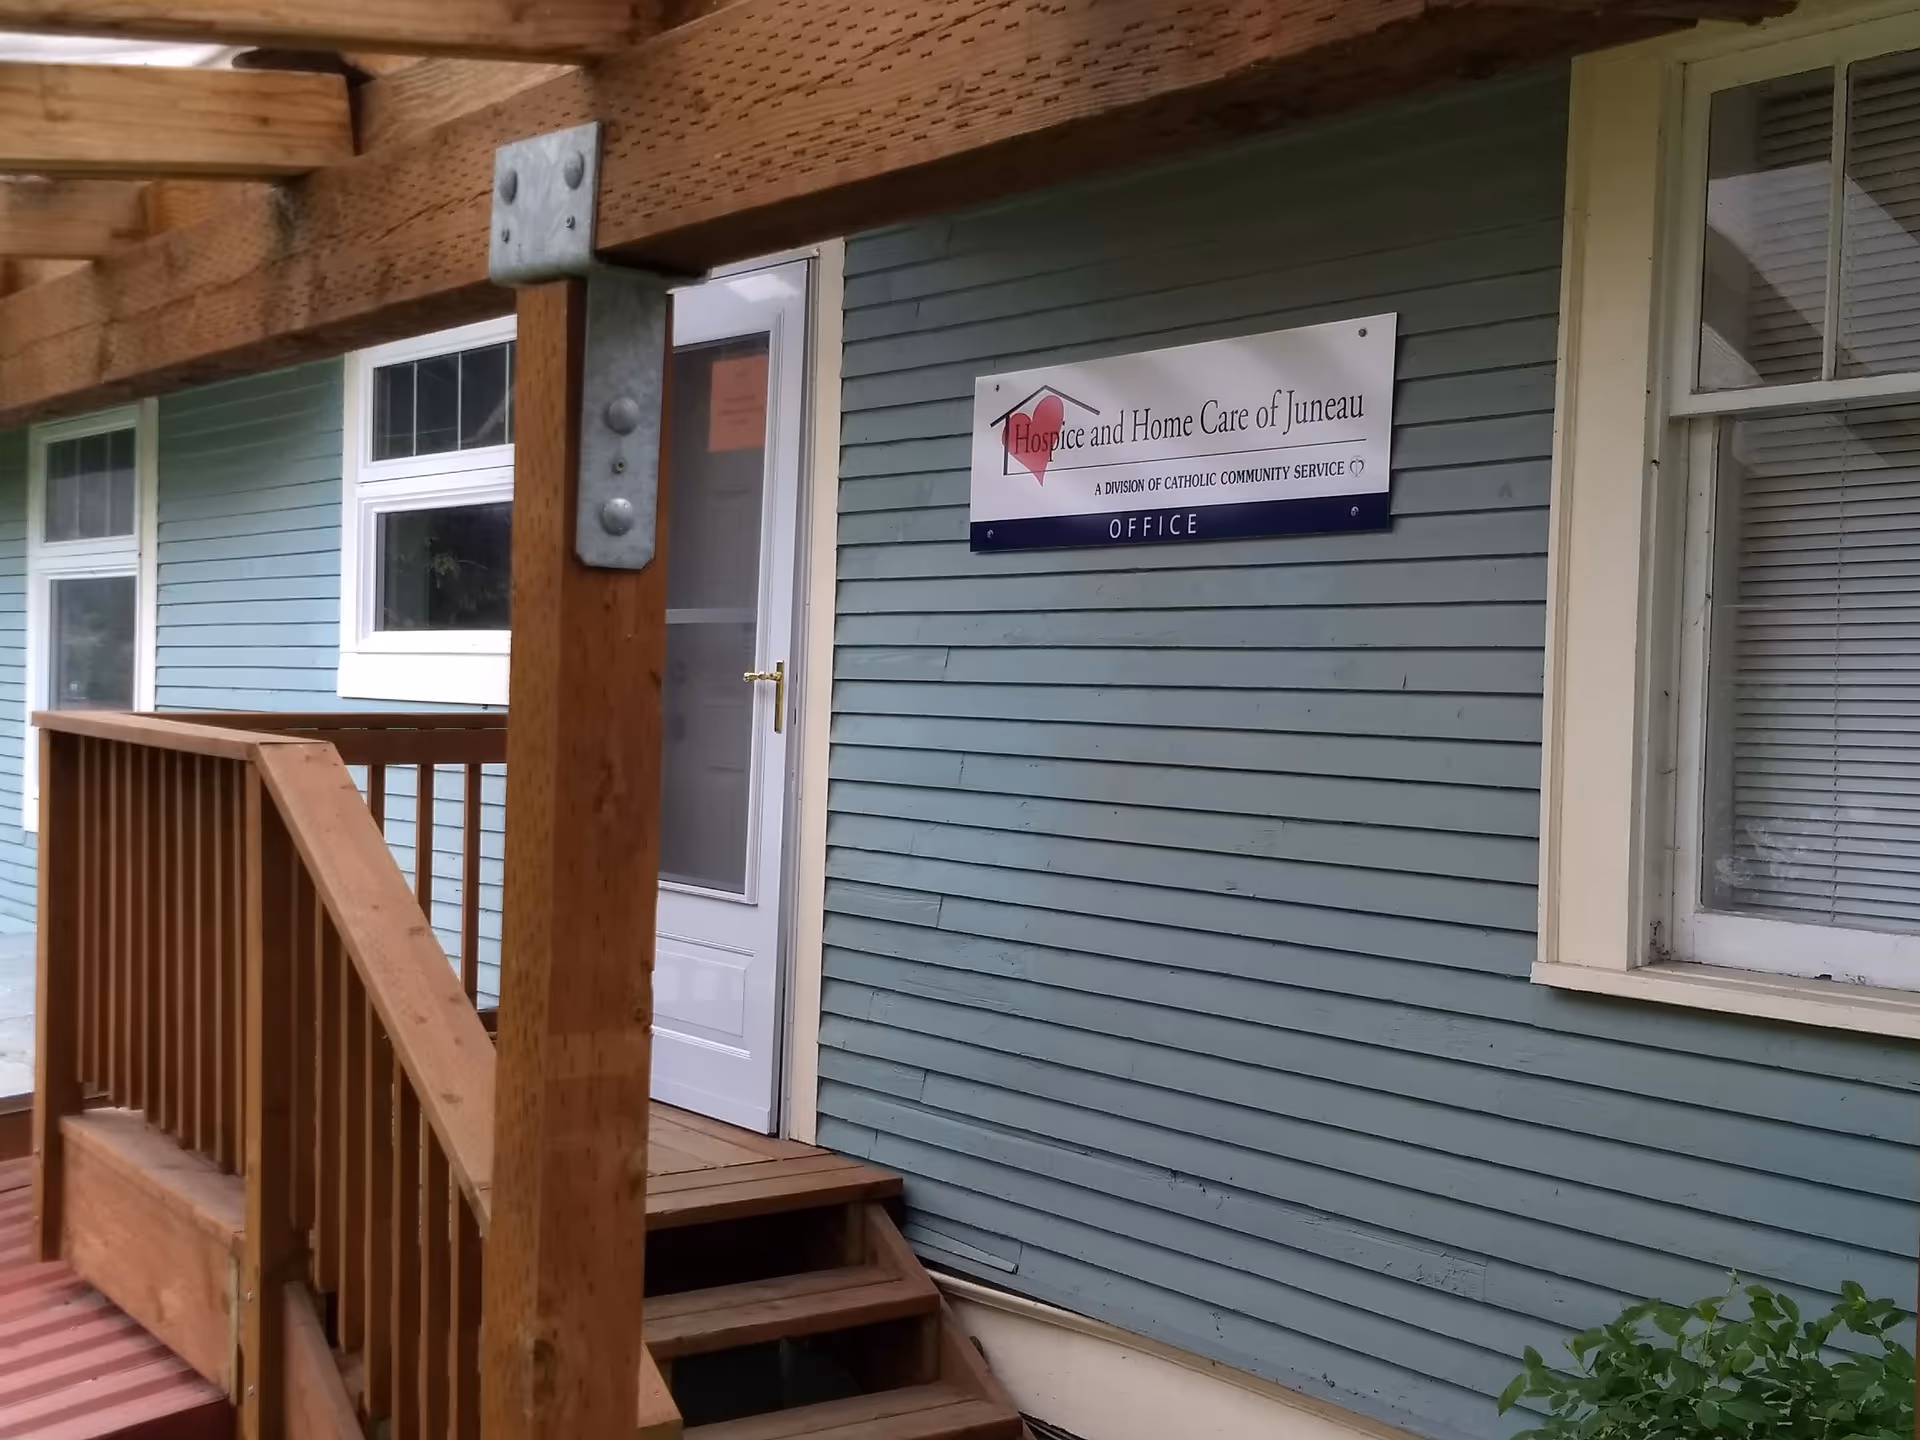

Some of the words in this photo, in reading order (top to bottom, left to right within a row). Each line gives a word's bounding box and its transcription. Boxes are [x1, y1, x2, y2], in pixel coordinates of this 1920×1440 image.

[1014, 419, 1085, 462] Hospice
[1090, 410, 1124, 448] and
[1132, 407, 1193, 443] Home
[1200, 399, 1249, 435] Care
[1256, 389, 1282, 429] of
[1282, 390, 1365, 435] Juneau
[1094, 482, 1102, 496] A
[1105, 478, 1145, 496] DIVISION
[1148, 477, 1161, 491] OF
[1164, 472, 1217, 490] CATHOLIC
[1220, 466, 1290, 486] COMMUNITY
[1294, 460, 1345, 479] SERVICE
[1109, 513, 1197, 539] OFFICE
